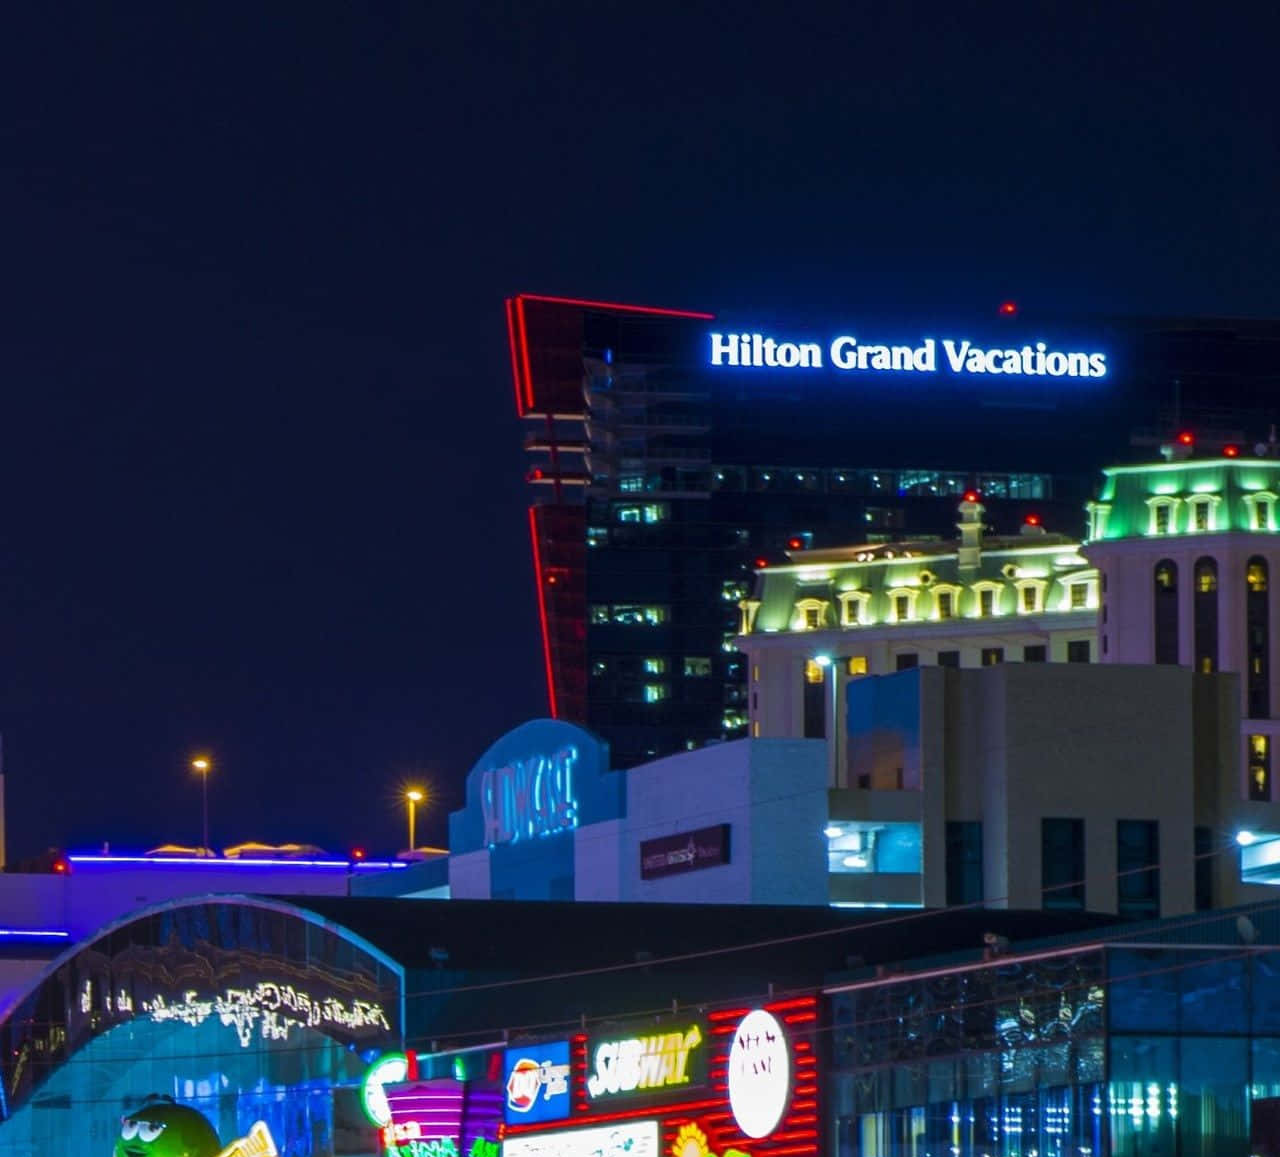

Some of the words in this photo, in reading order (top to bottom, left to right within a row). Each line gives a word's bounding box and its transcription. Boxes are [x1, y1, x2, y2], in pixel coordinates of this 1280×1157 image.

[710, 333, 821, 368] Hilton
[830, 336, 936, 371] Grand
[943, 340, 1107, 378] Vacations
[588, 1025, 702, 1098] SUBWAY
